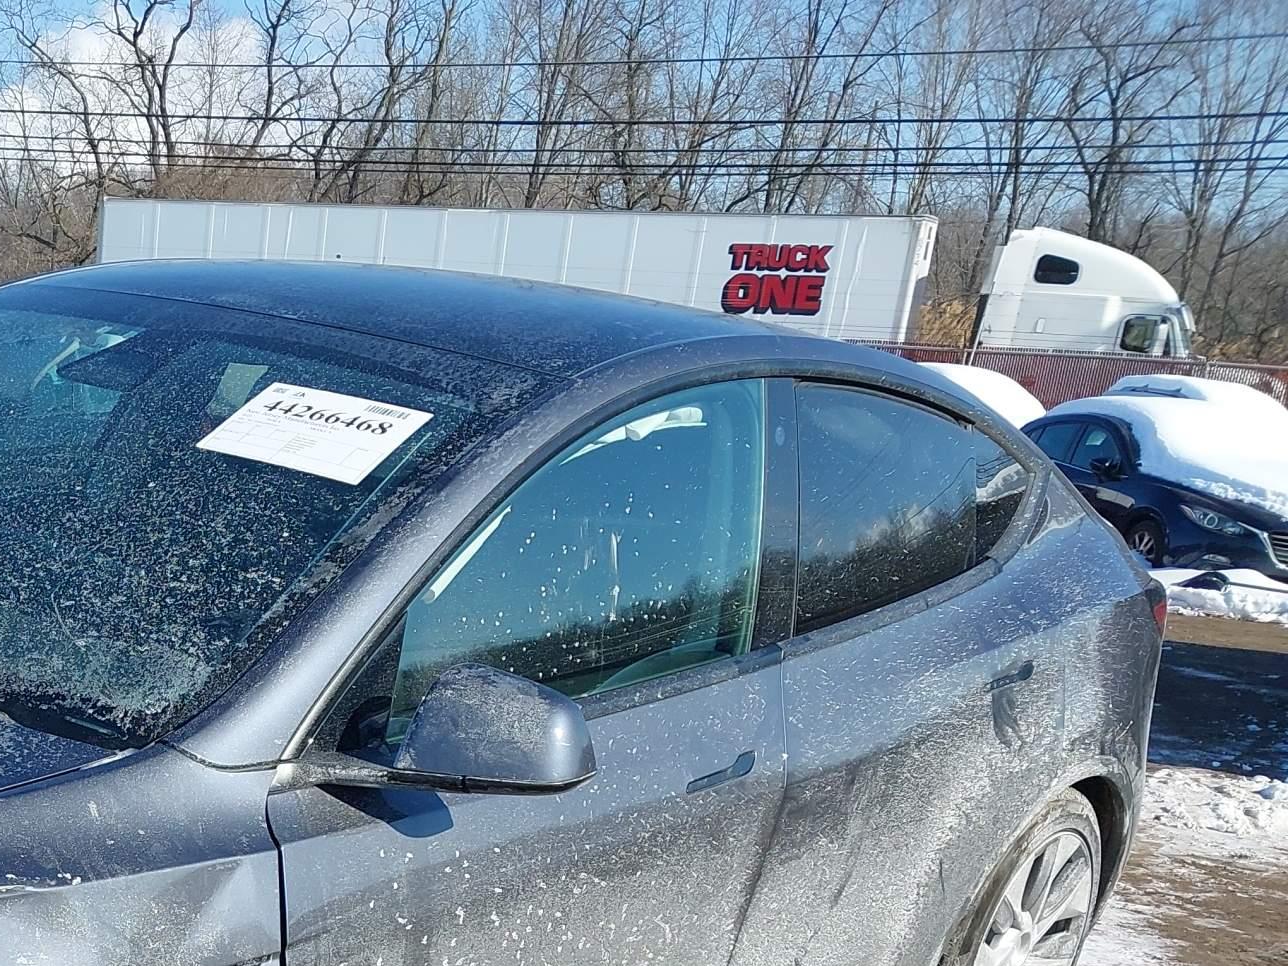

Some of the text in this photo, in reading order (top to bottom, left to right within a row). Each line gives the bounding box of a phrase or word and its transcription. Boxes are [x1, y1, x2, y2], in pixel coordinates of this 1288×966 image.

[728, 243, 833, 272] TRUCK
[721, 273, 825, 315] ONE
[263, 400, 393, 435] 44266468
